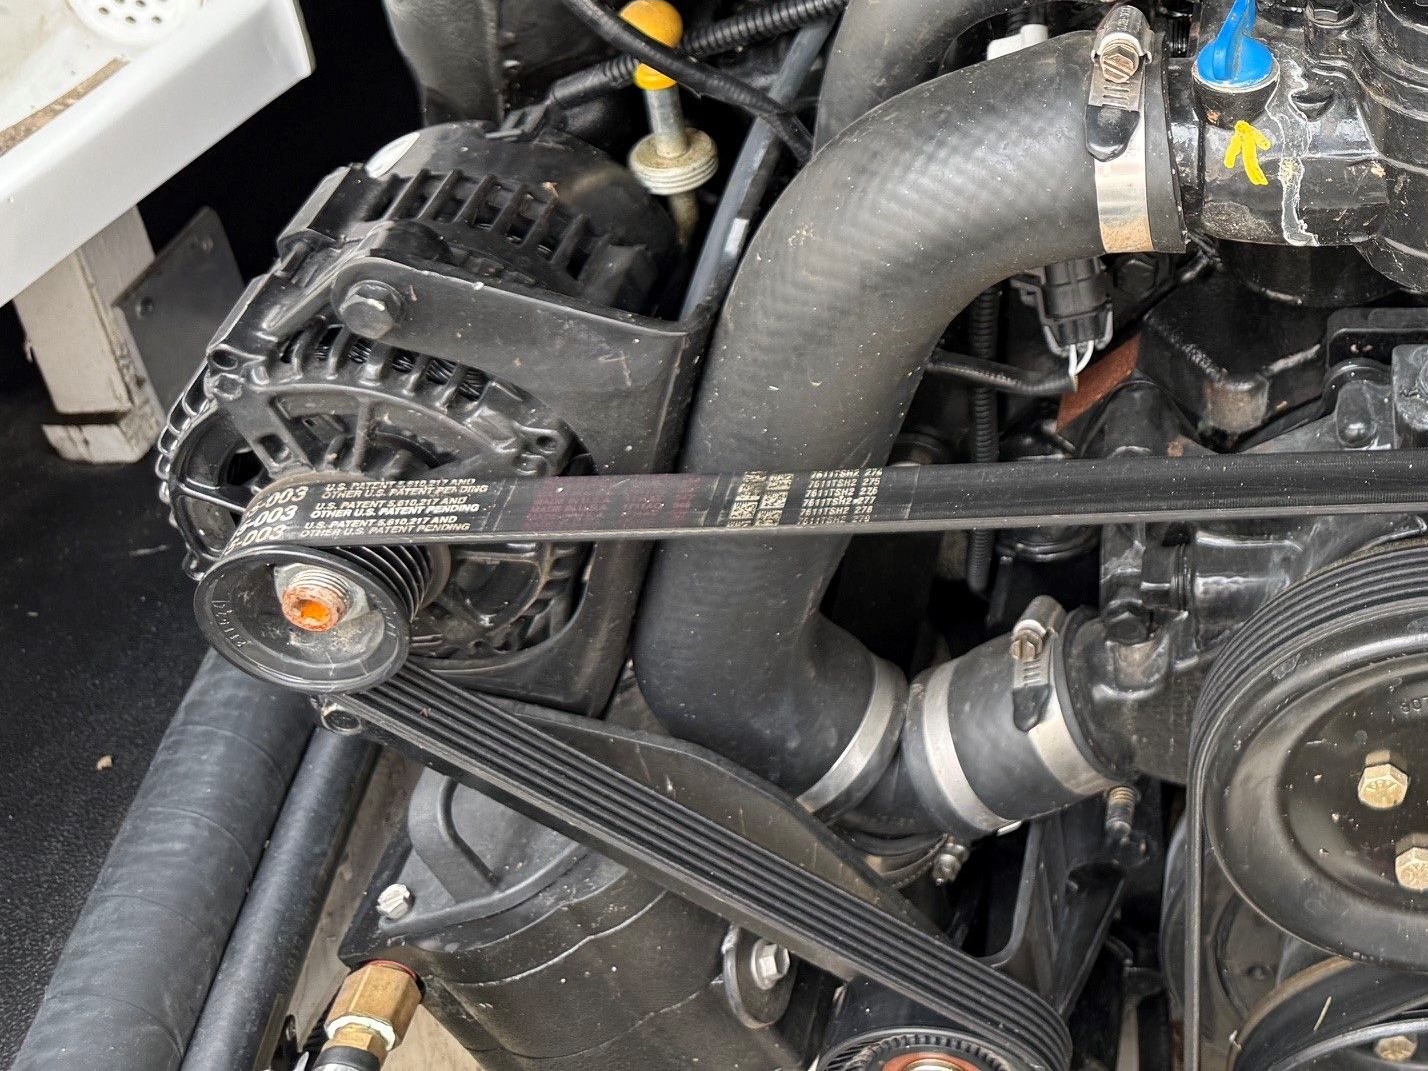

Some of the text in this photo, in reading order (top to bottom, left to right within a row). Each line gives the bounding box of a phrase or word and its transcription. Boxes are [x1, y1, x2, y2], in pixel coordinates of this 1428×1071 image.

[325, 482, 347, 491] U.S.
[351, 480, 397, 490] PATENT
[449, 478, 476, 487] AND
[321, 490, 363, 499] OTHER
[364, 489, 387, 498] U.S.
[389, 487, 434, 496] PATENT
[804, 486, 878, 498] 7611TSH2 276
[315, 496, 468, 511] U.S. PATENT 5,610,217 AND
[801, 496, 852, 507] 7611TSH2
[310, 503, 480, 518] OTHER U.S. PATENT PENDING
[304, 521, 327, 529] U.S.
[329, 518, 377, 528] PATENT
[430, 515, 458, 524] AND
[300, 523, 472, 537] OTHER U.S. PATENT PENDING
